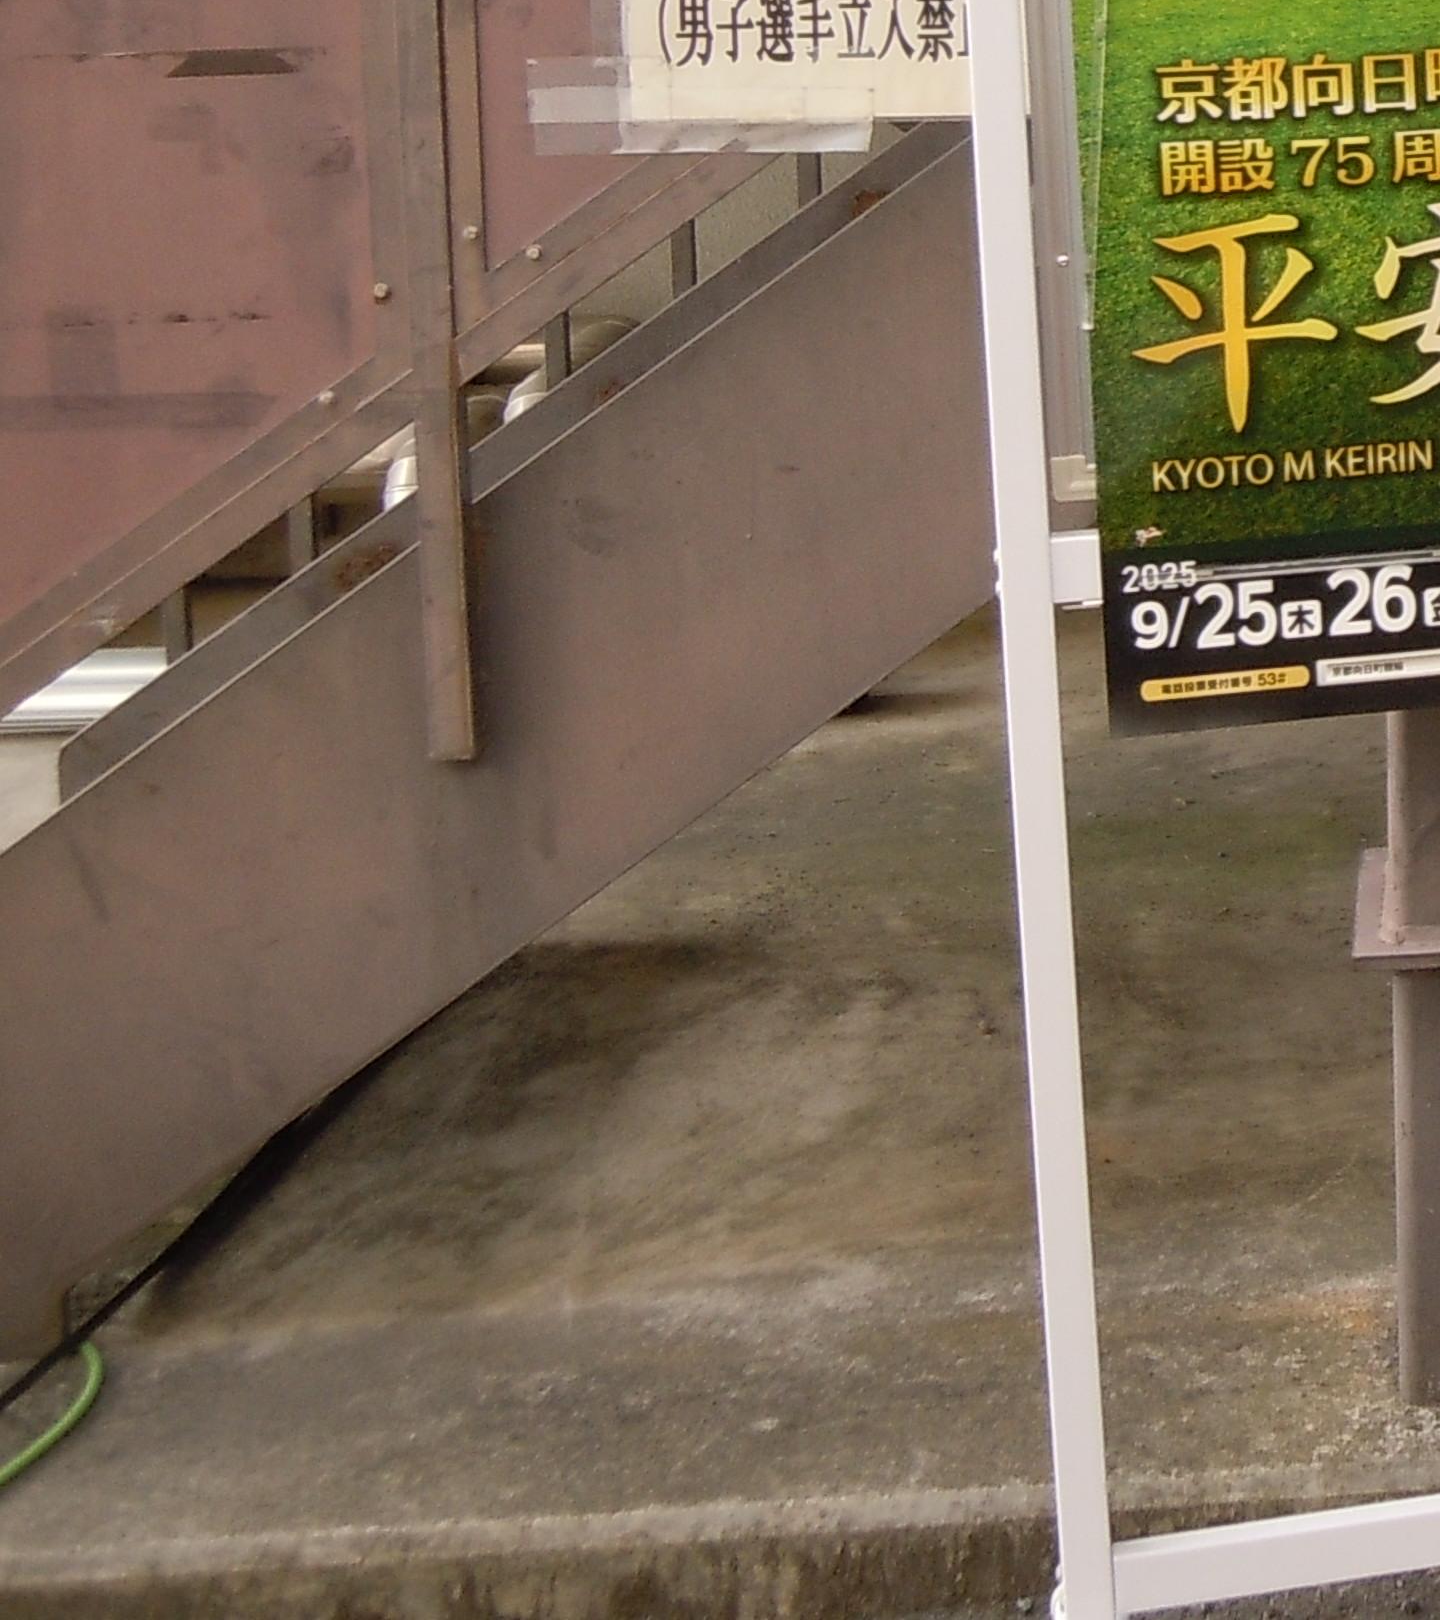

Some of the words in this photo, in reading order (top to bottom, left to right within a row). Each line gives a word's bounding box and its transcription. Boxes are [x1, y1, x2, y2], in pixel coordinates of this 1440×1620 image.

[1152, 454, 1274, 492] KYOTO
[1284, 450, 1314, 482] M
[1325, 440, 1433, 479] KEIRIN
[1121, 560, 1198, 594] 2025
[1130, 579, 1278, 650] 9/25
[1326, 565, 1418, 636] 26
